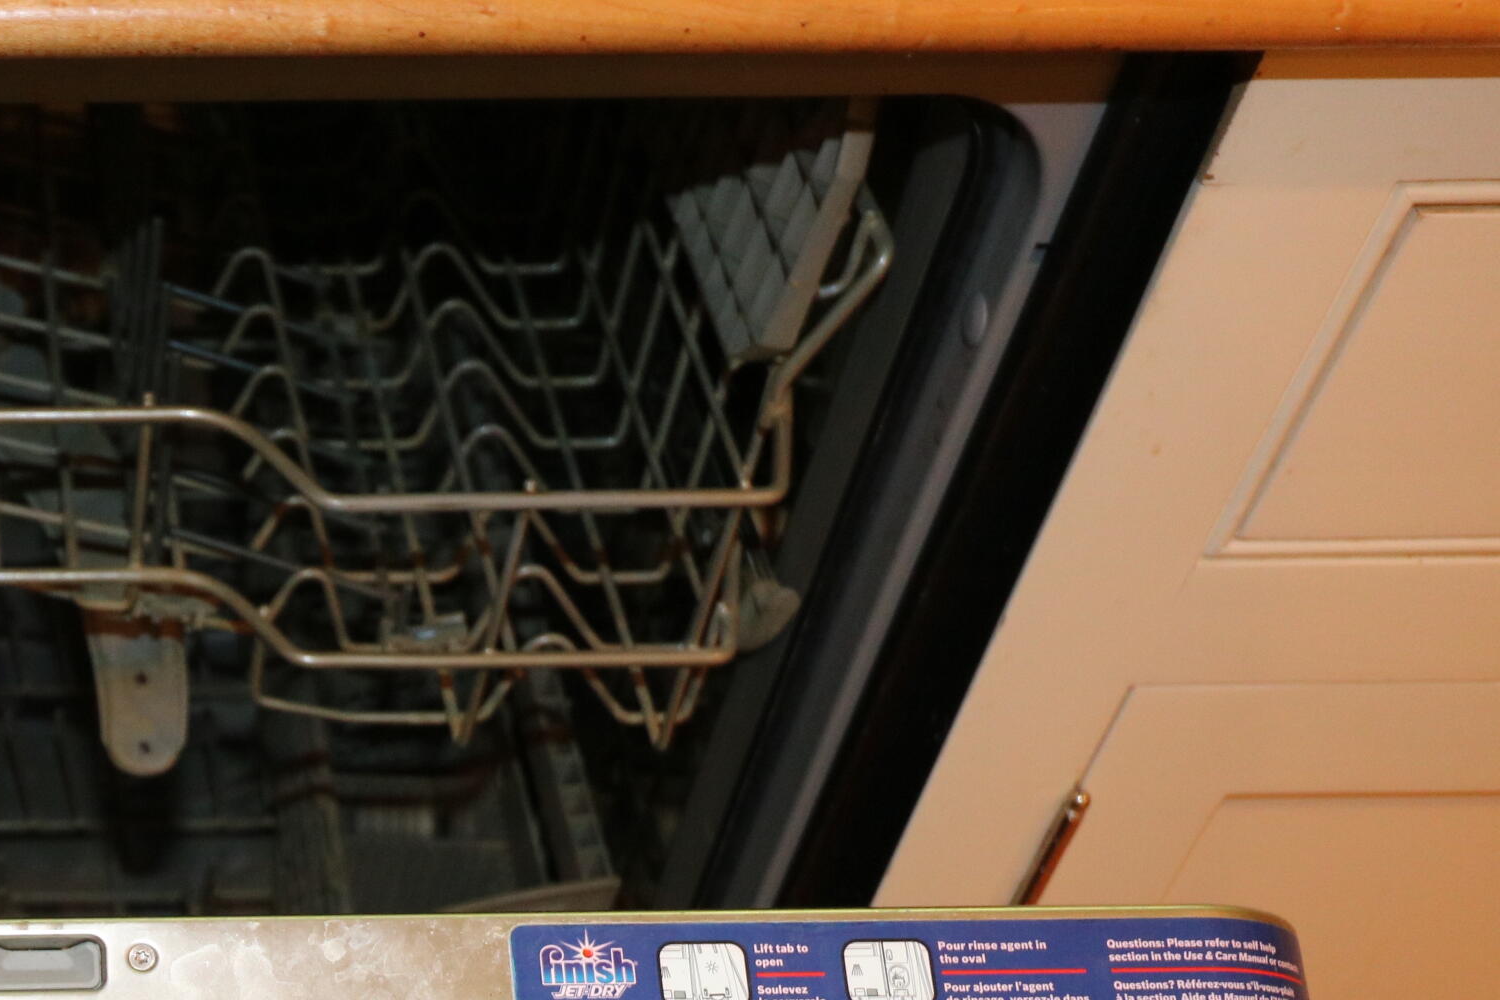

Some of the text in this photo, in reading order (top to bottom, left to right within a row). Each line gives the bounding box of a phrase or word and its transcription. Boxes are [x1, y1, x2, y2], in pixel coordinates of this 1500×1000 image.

[753, 943, 808, 954] Lift tab to
[937, 940, 1047, 952] Pour rinse agent in
[1107, 938, 1165, 949] Questions:
[1166, 938, 1203, 948] Please
[1205, 938, 1229, 948] refer
[1231, 939, 1242, 949] to
[1243, 940, 1258, 950] self
[539, 944, 637, 985] finish
[755, 957, 784, 968] open
[940, 954, 986, 964] the oval
[1108, 952, 1149, 962] section
[1151, 951, 1161, 961] in
[1163, 951, 1181, 960] the
[1183, 951, 1203, 961] Use
[1205, 951, 1213, 960] &
[1215, 951, 1237, 961] Care
[1239, 952, 1268, 965] Manual
[1269, 958, 1277, 966] or
[757, 985, 808, 995] Soulevez
[943, 981, 1054, 994] Pour ajouter l'agent
[1113, 980, 1174, 990] Questions?
[551, 984, 627, 999] JET-DRY
